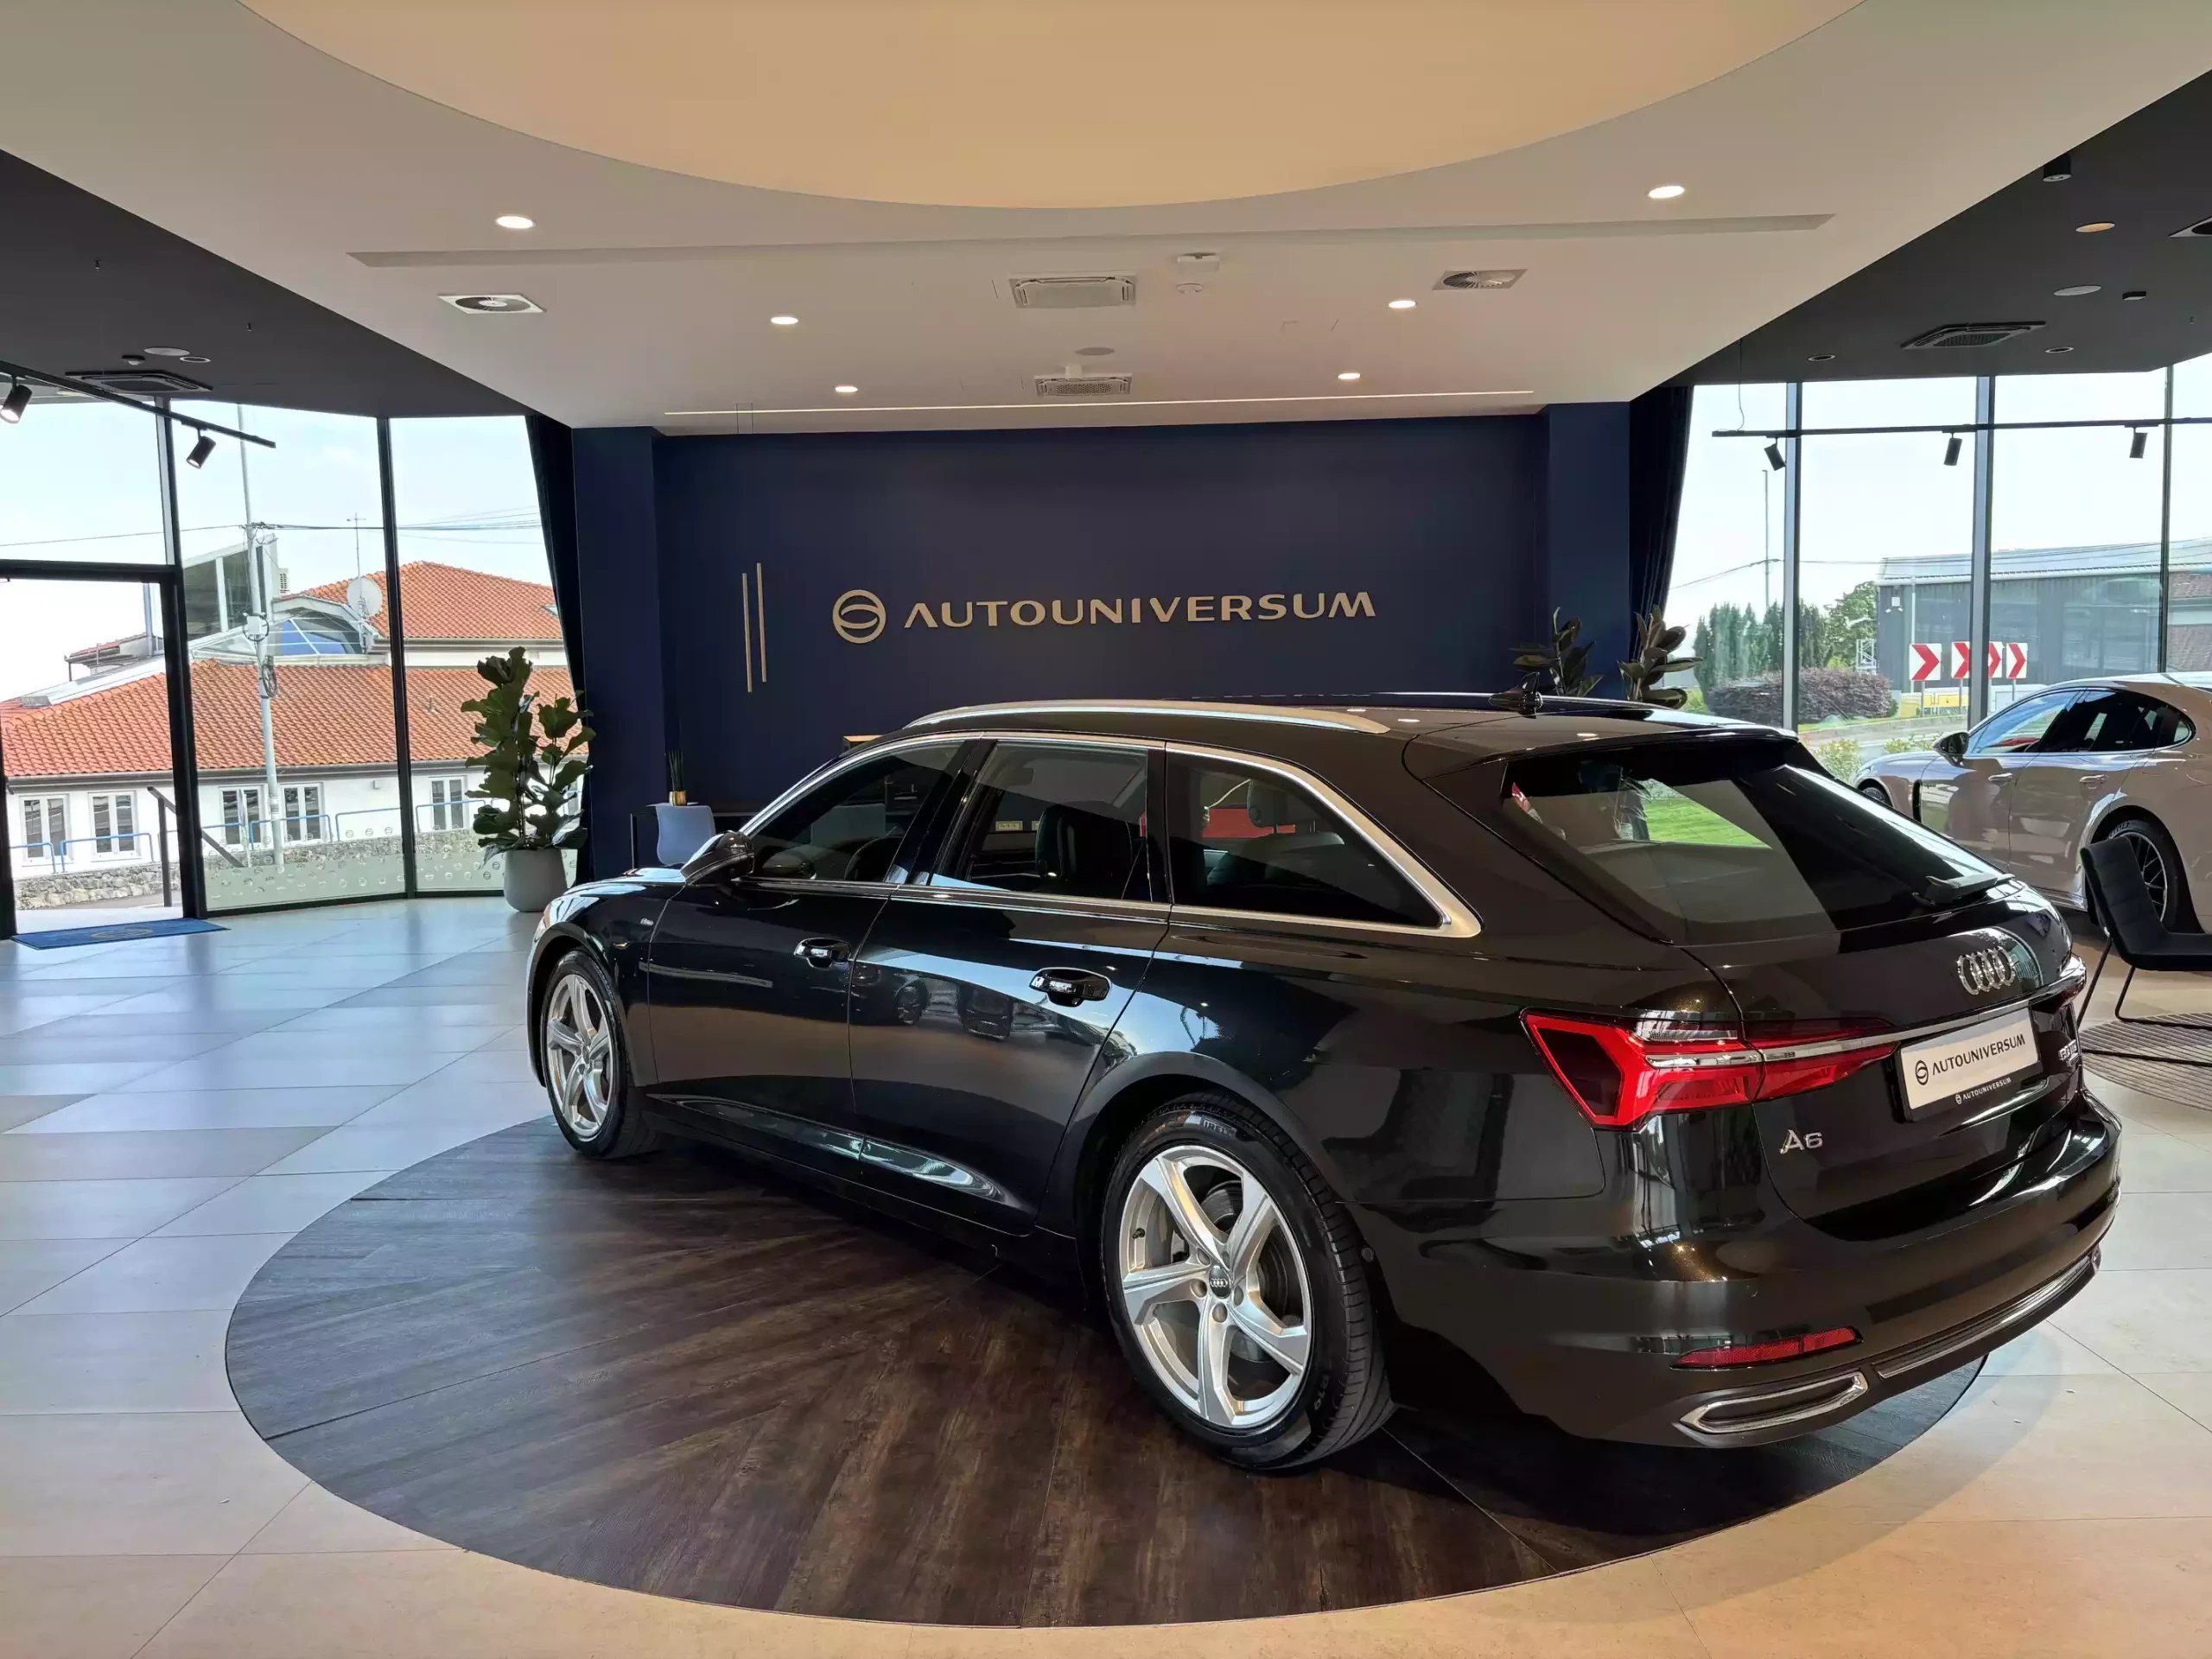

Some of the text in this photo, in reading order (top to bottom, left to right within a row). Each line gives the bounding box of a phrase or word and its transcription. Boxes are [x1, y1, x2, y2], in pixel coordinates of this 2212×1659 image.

[904, 592, 1376, 629] AUTOUNIVERSUM
[1932, 1034, 2026, 1076] AUTOUNIVERSUM
[1962, 1077, 2012, 1101] AUTOUNIVERSUM
[1780, 1128, 1823, 1154] A6
